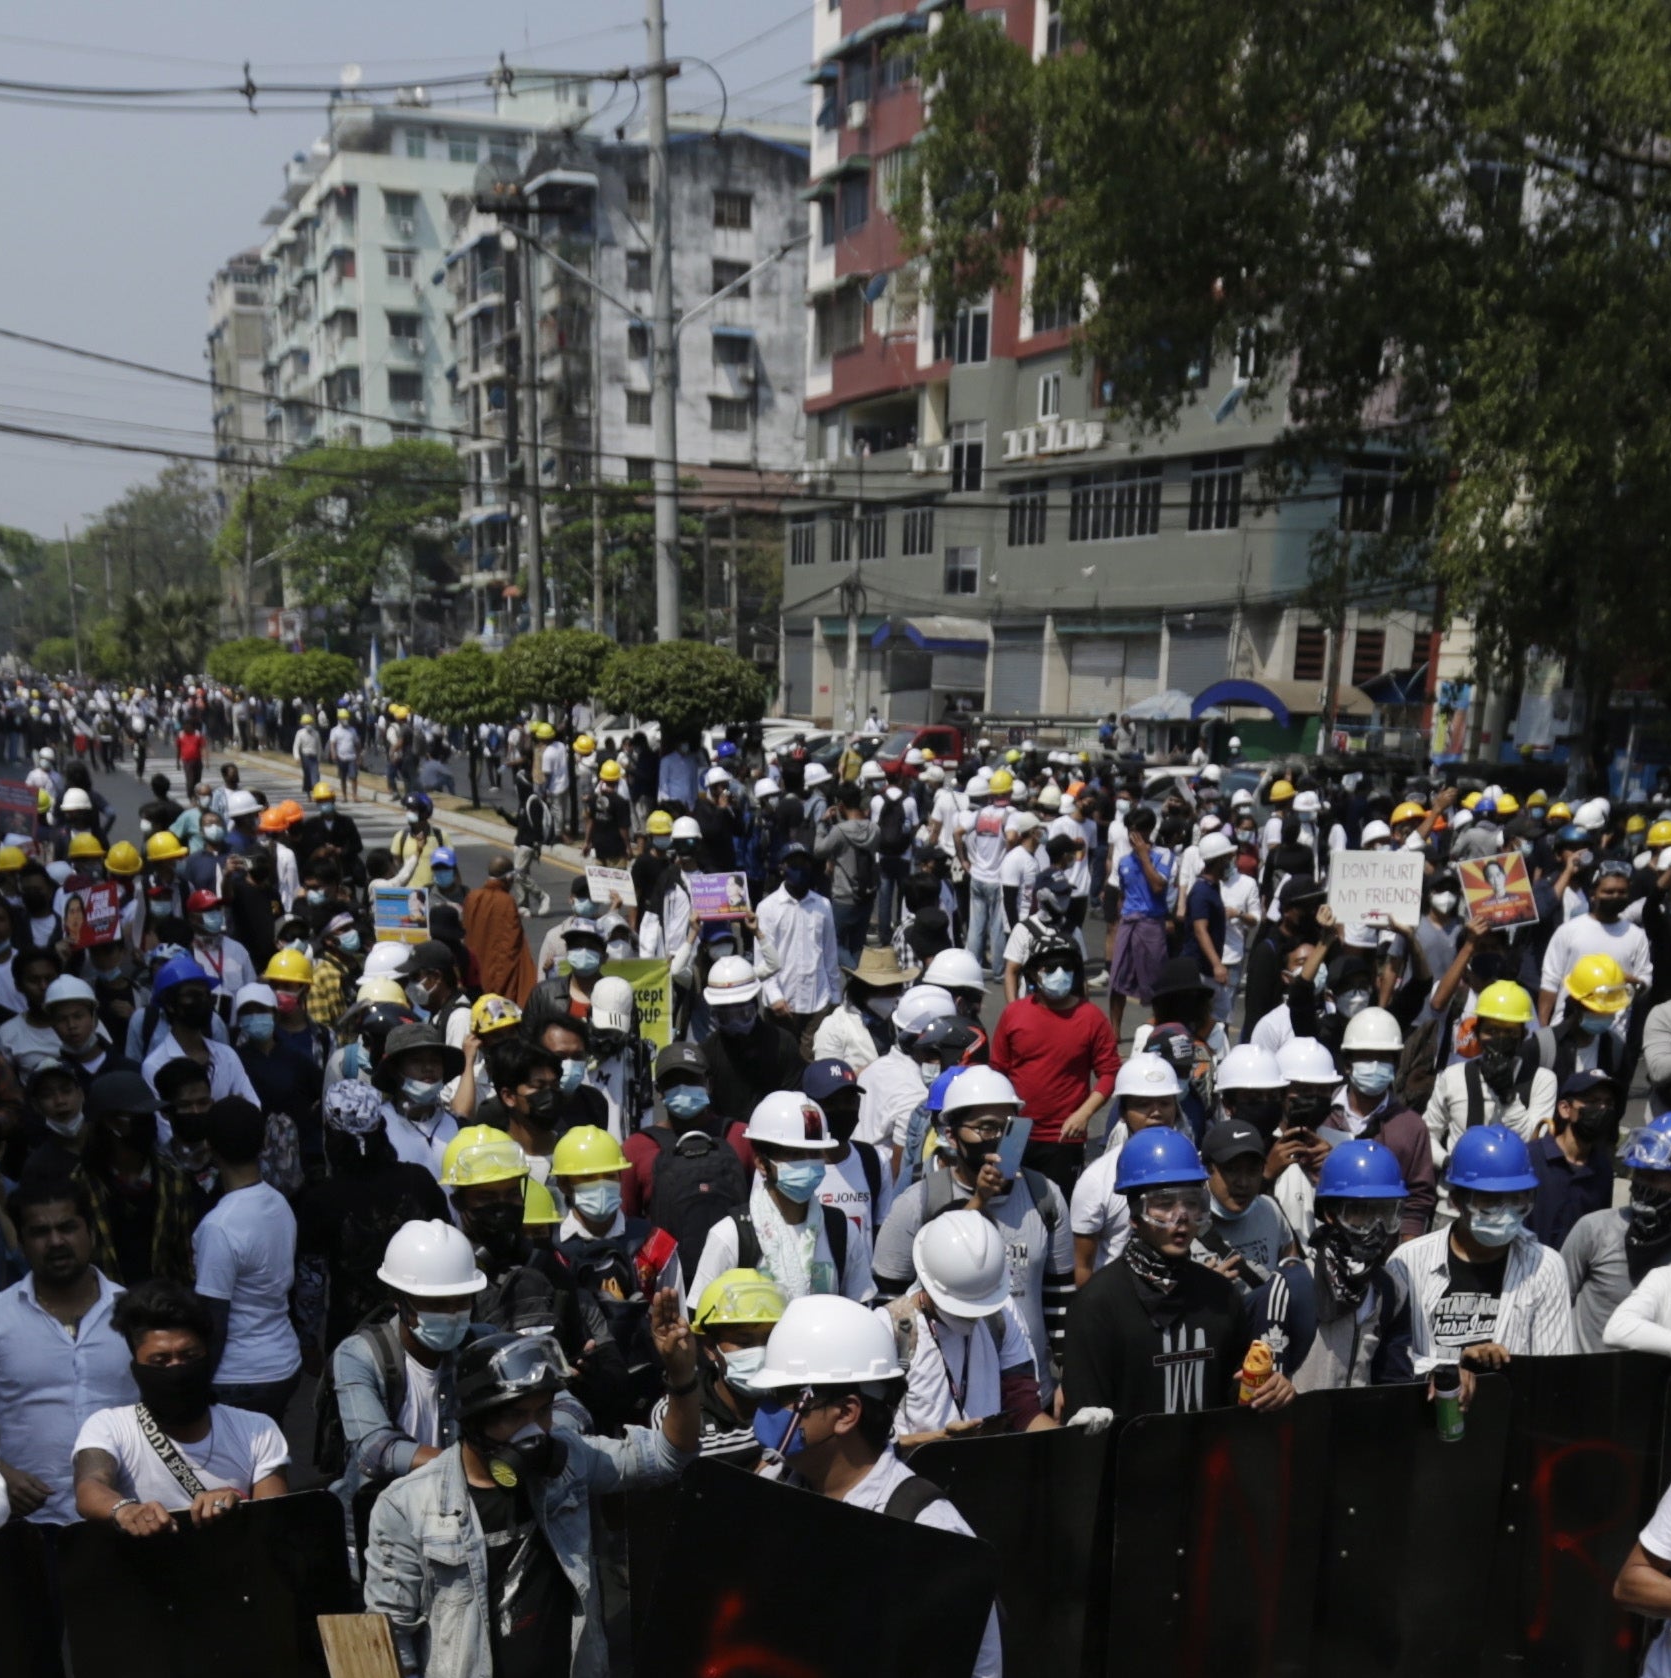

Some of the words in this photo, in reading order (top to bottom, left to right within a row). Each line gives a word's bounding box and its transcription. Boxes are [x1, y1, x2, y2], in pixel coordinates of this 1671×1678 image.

[1341, 862, 1379, 881] DON'T
[1383, 862, 1416, 881] HURT
[1338, 888, 1359, 903] MY
[1366, 887, 1421, 904] FRIENDS
[633, 988, 664, 1006] ccept
[637, 1008, 662, 1024] OUP
[833, 1191, 870, 1203] JONES
